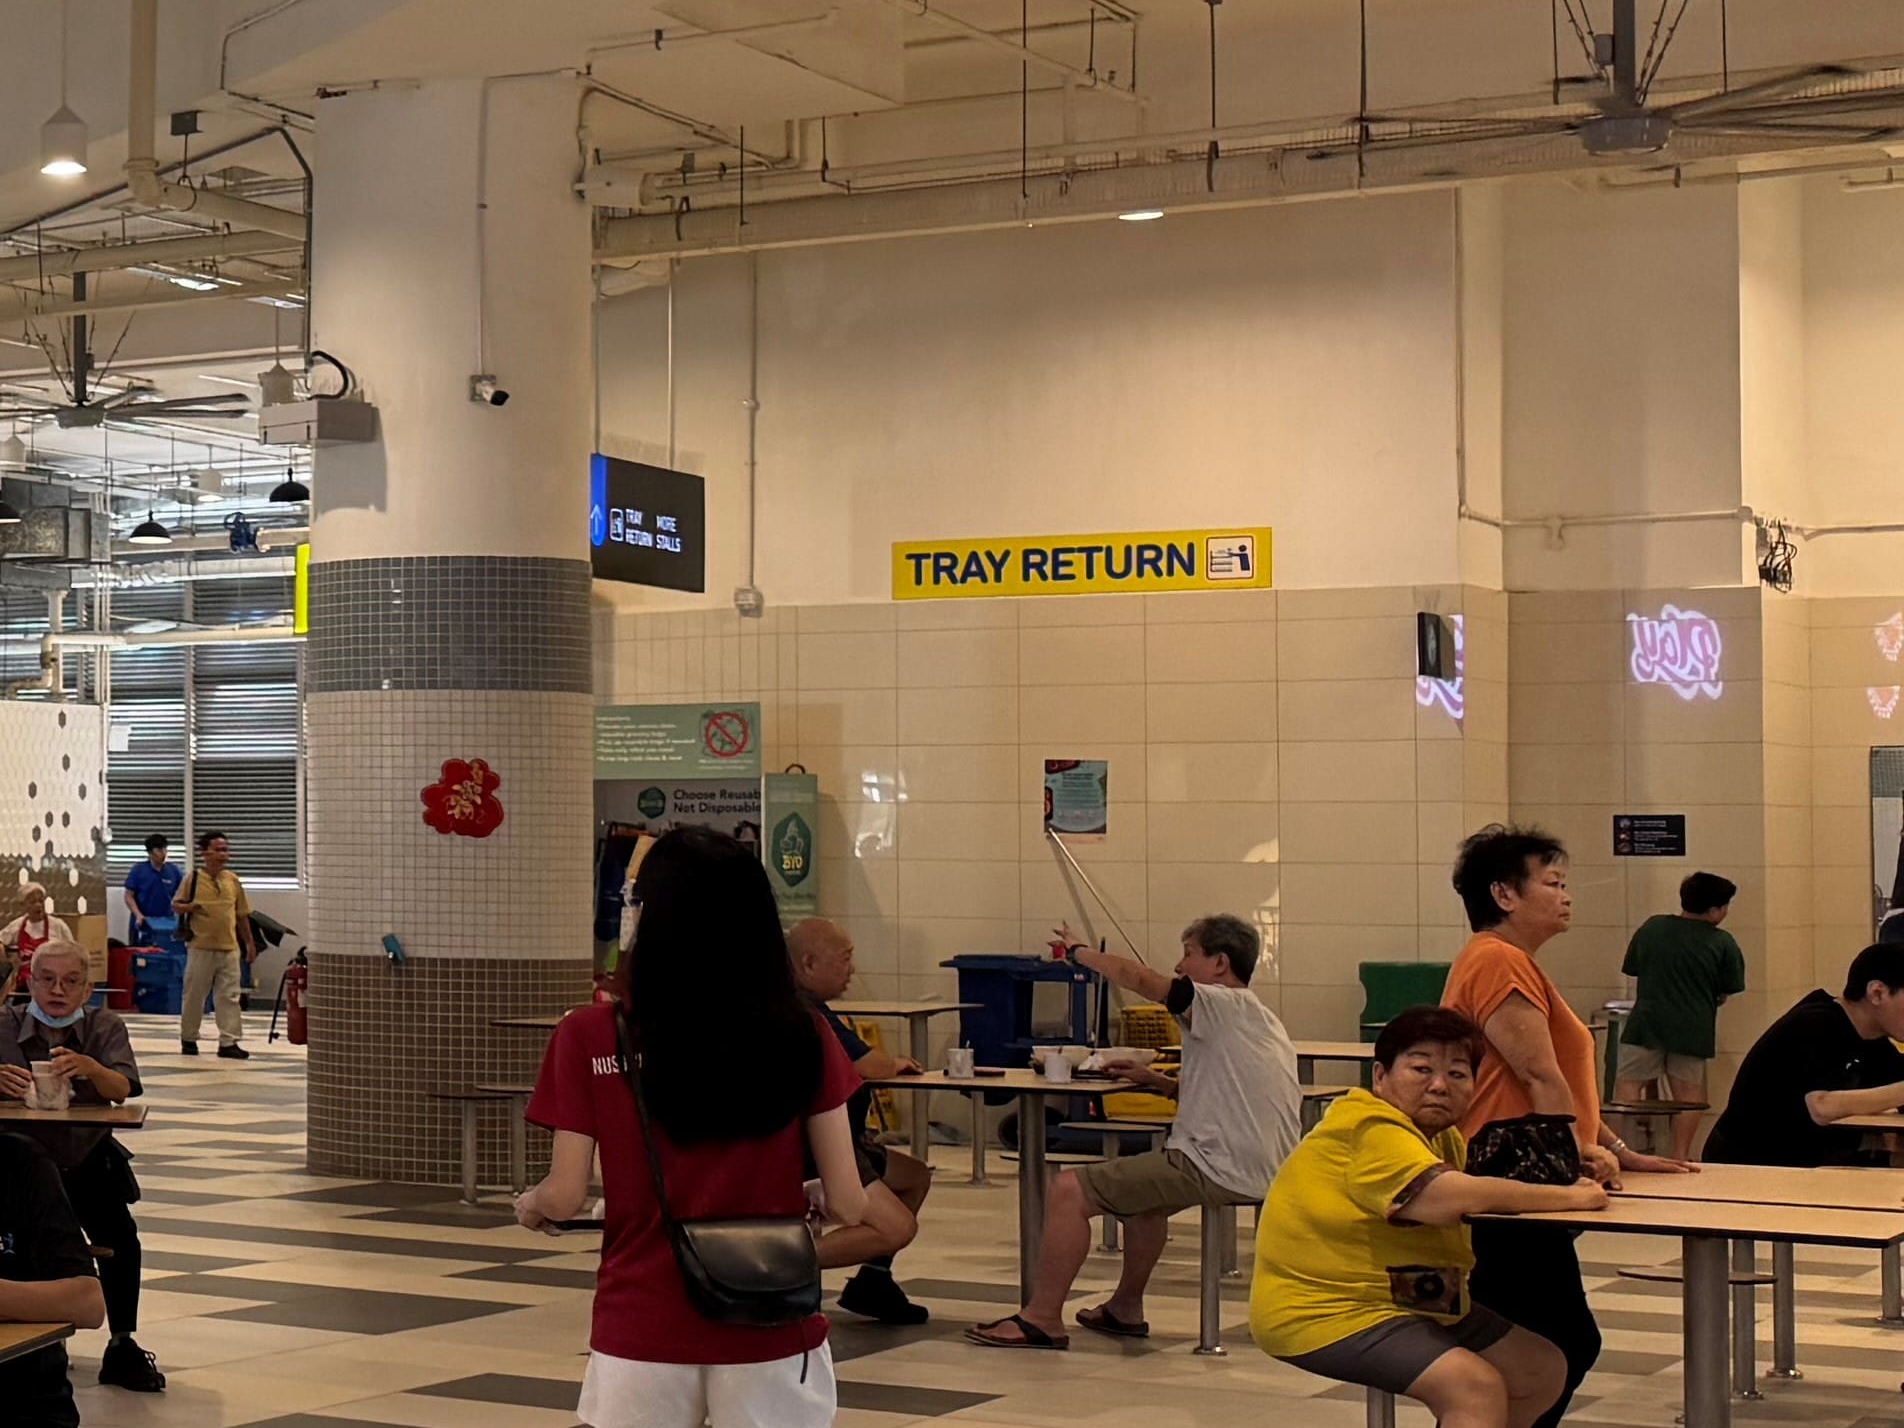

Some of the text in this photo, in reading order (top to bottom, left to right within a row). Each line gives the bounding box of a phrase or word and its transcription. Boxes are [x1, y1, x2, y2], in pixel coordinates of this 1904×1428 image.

[625, 508, 643, 525] TRAY
[905, 542, 1195, 586] TRAY RETURN
[673, 788, 716, 801] Choose
[673, 802, 762, 815] Not Disposable
